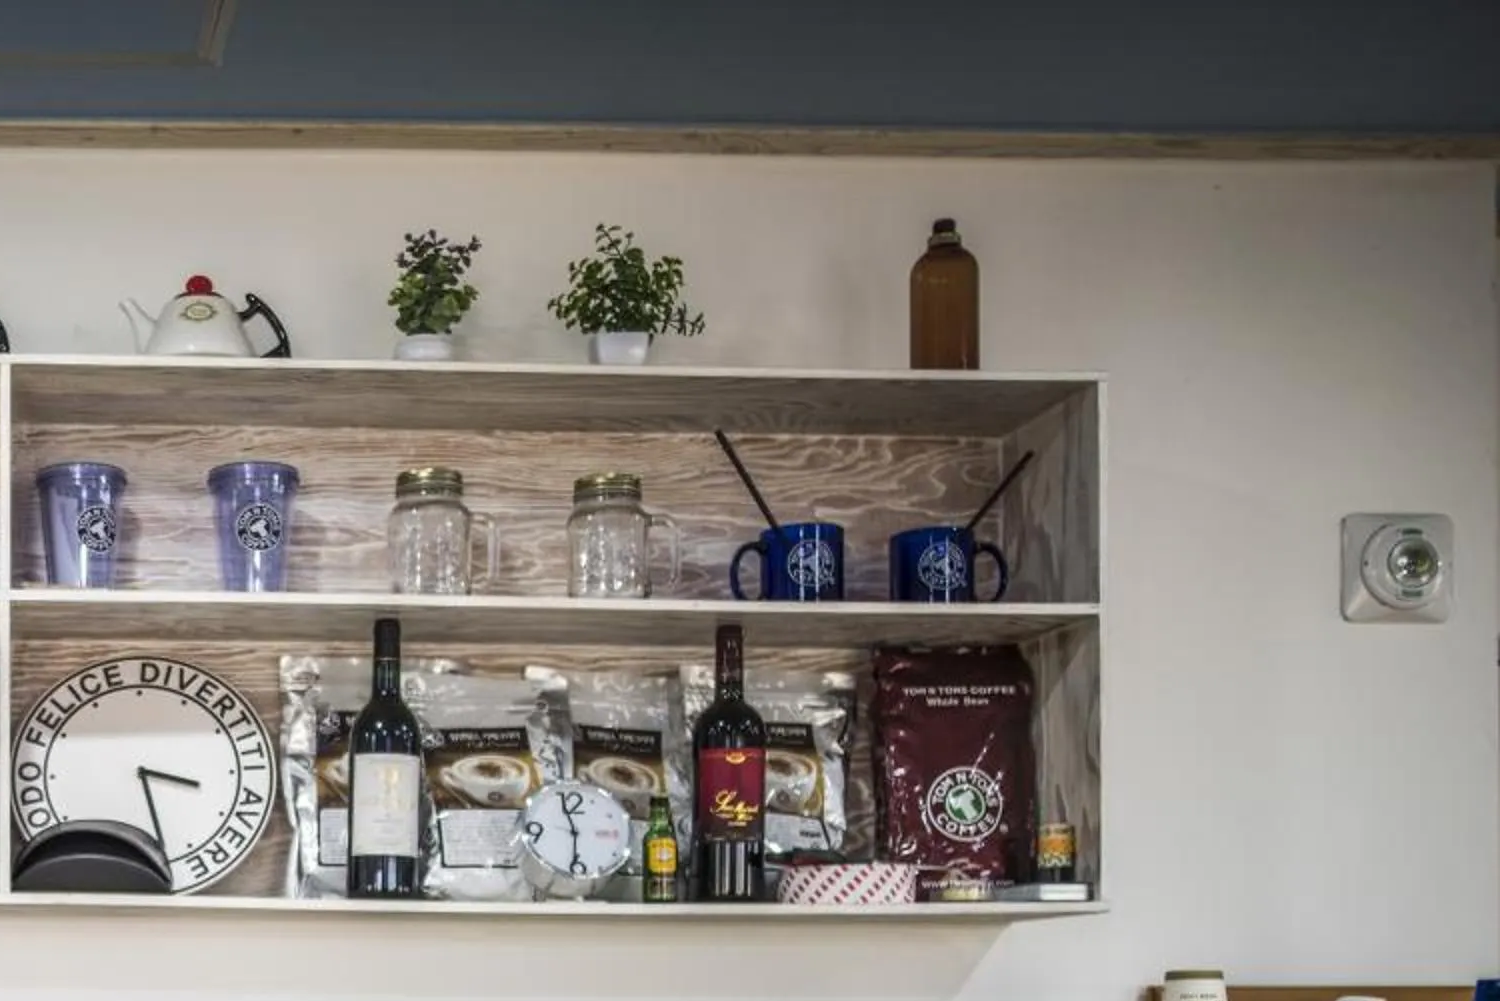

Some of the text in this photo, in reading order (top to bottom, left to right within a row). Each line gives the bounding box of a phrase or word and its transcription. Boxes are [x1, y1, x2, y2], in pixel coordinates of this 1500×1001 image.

[25, 664, 124, 748] FELICE
[903, 687, 928, 696] TOM
[938, 686, 968, 695] TOMS
[970, 686, 1016, 695] COFFEE
[139, 662, 266, 771] DIVERTITI
[933, 777, 954, 805] TOM
[955, 772, 968, 783] N
[185, 787, 263, 879] AVERE
[526, 821, 544, 844] 9
[937, 811, 995, 836] COFFEE
